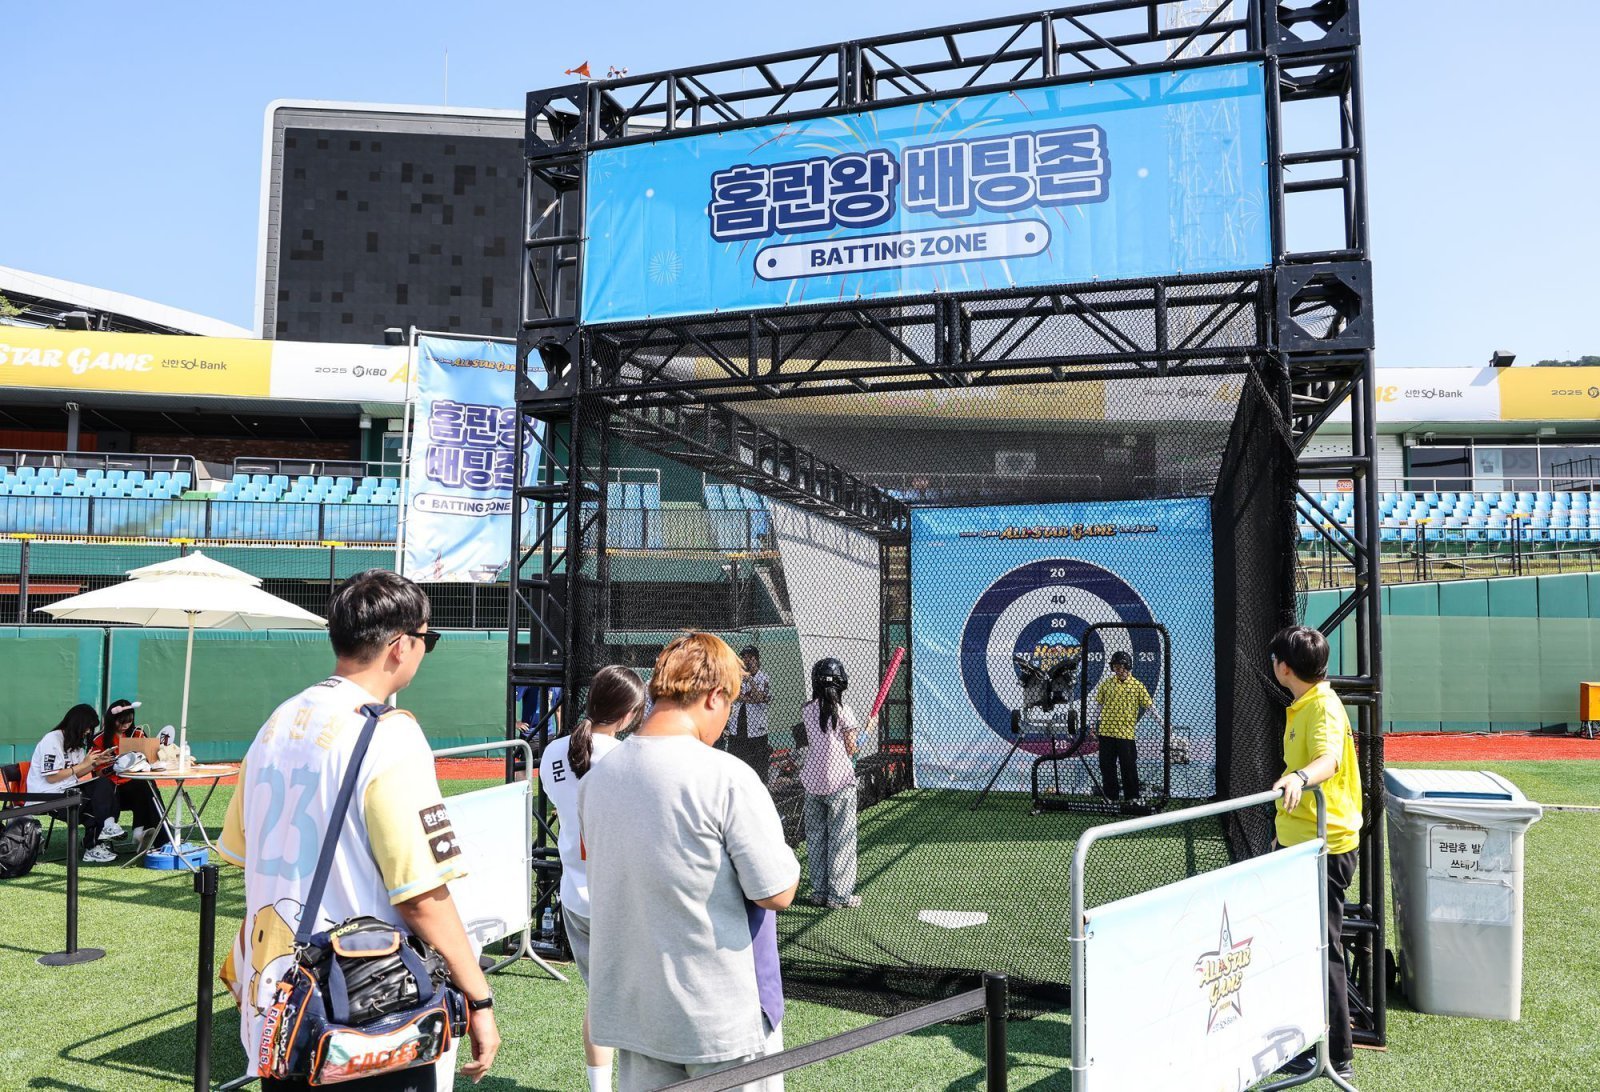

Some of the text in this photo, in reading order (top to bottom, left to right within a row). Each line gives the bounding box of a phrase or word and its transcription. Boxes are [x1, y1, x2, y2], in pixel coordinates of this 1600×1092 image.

[708, 123, 1111, 243] 홈런왕 배팅존
[810, 231, 988, 268] BATTING ZONE
[66, 347, 154, 375] GAME
[161, 358, 179, 369] 신한
[200, 361, 227, 371] Bank
[365, 368, 388, 377] KBO
[1404, 389, 1420, 399] 신한
[1438, 389, 1463, 398] Bank
[432, 499, 511, 513] BATTING ZONE
[1050, 568, 1066, 578] 20
[1051, 595, 1066, 604] 40
[1051, 618, 1066, 628] 80
[552, 759, 566, 783] 문
[254, 763, 321, 880] 23
[1438, 842, 1468, 854] 관람후
[260, 1007, 279, 1065] EAGLES
[346, 1040, 422, 1074] EAGLES
